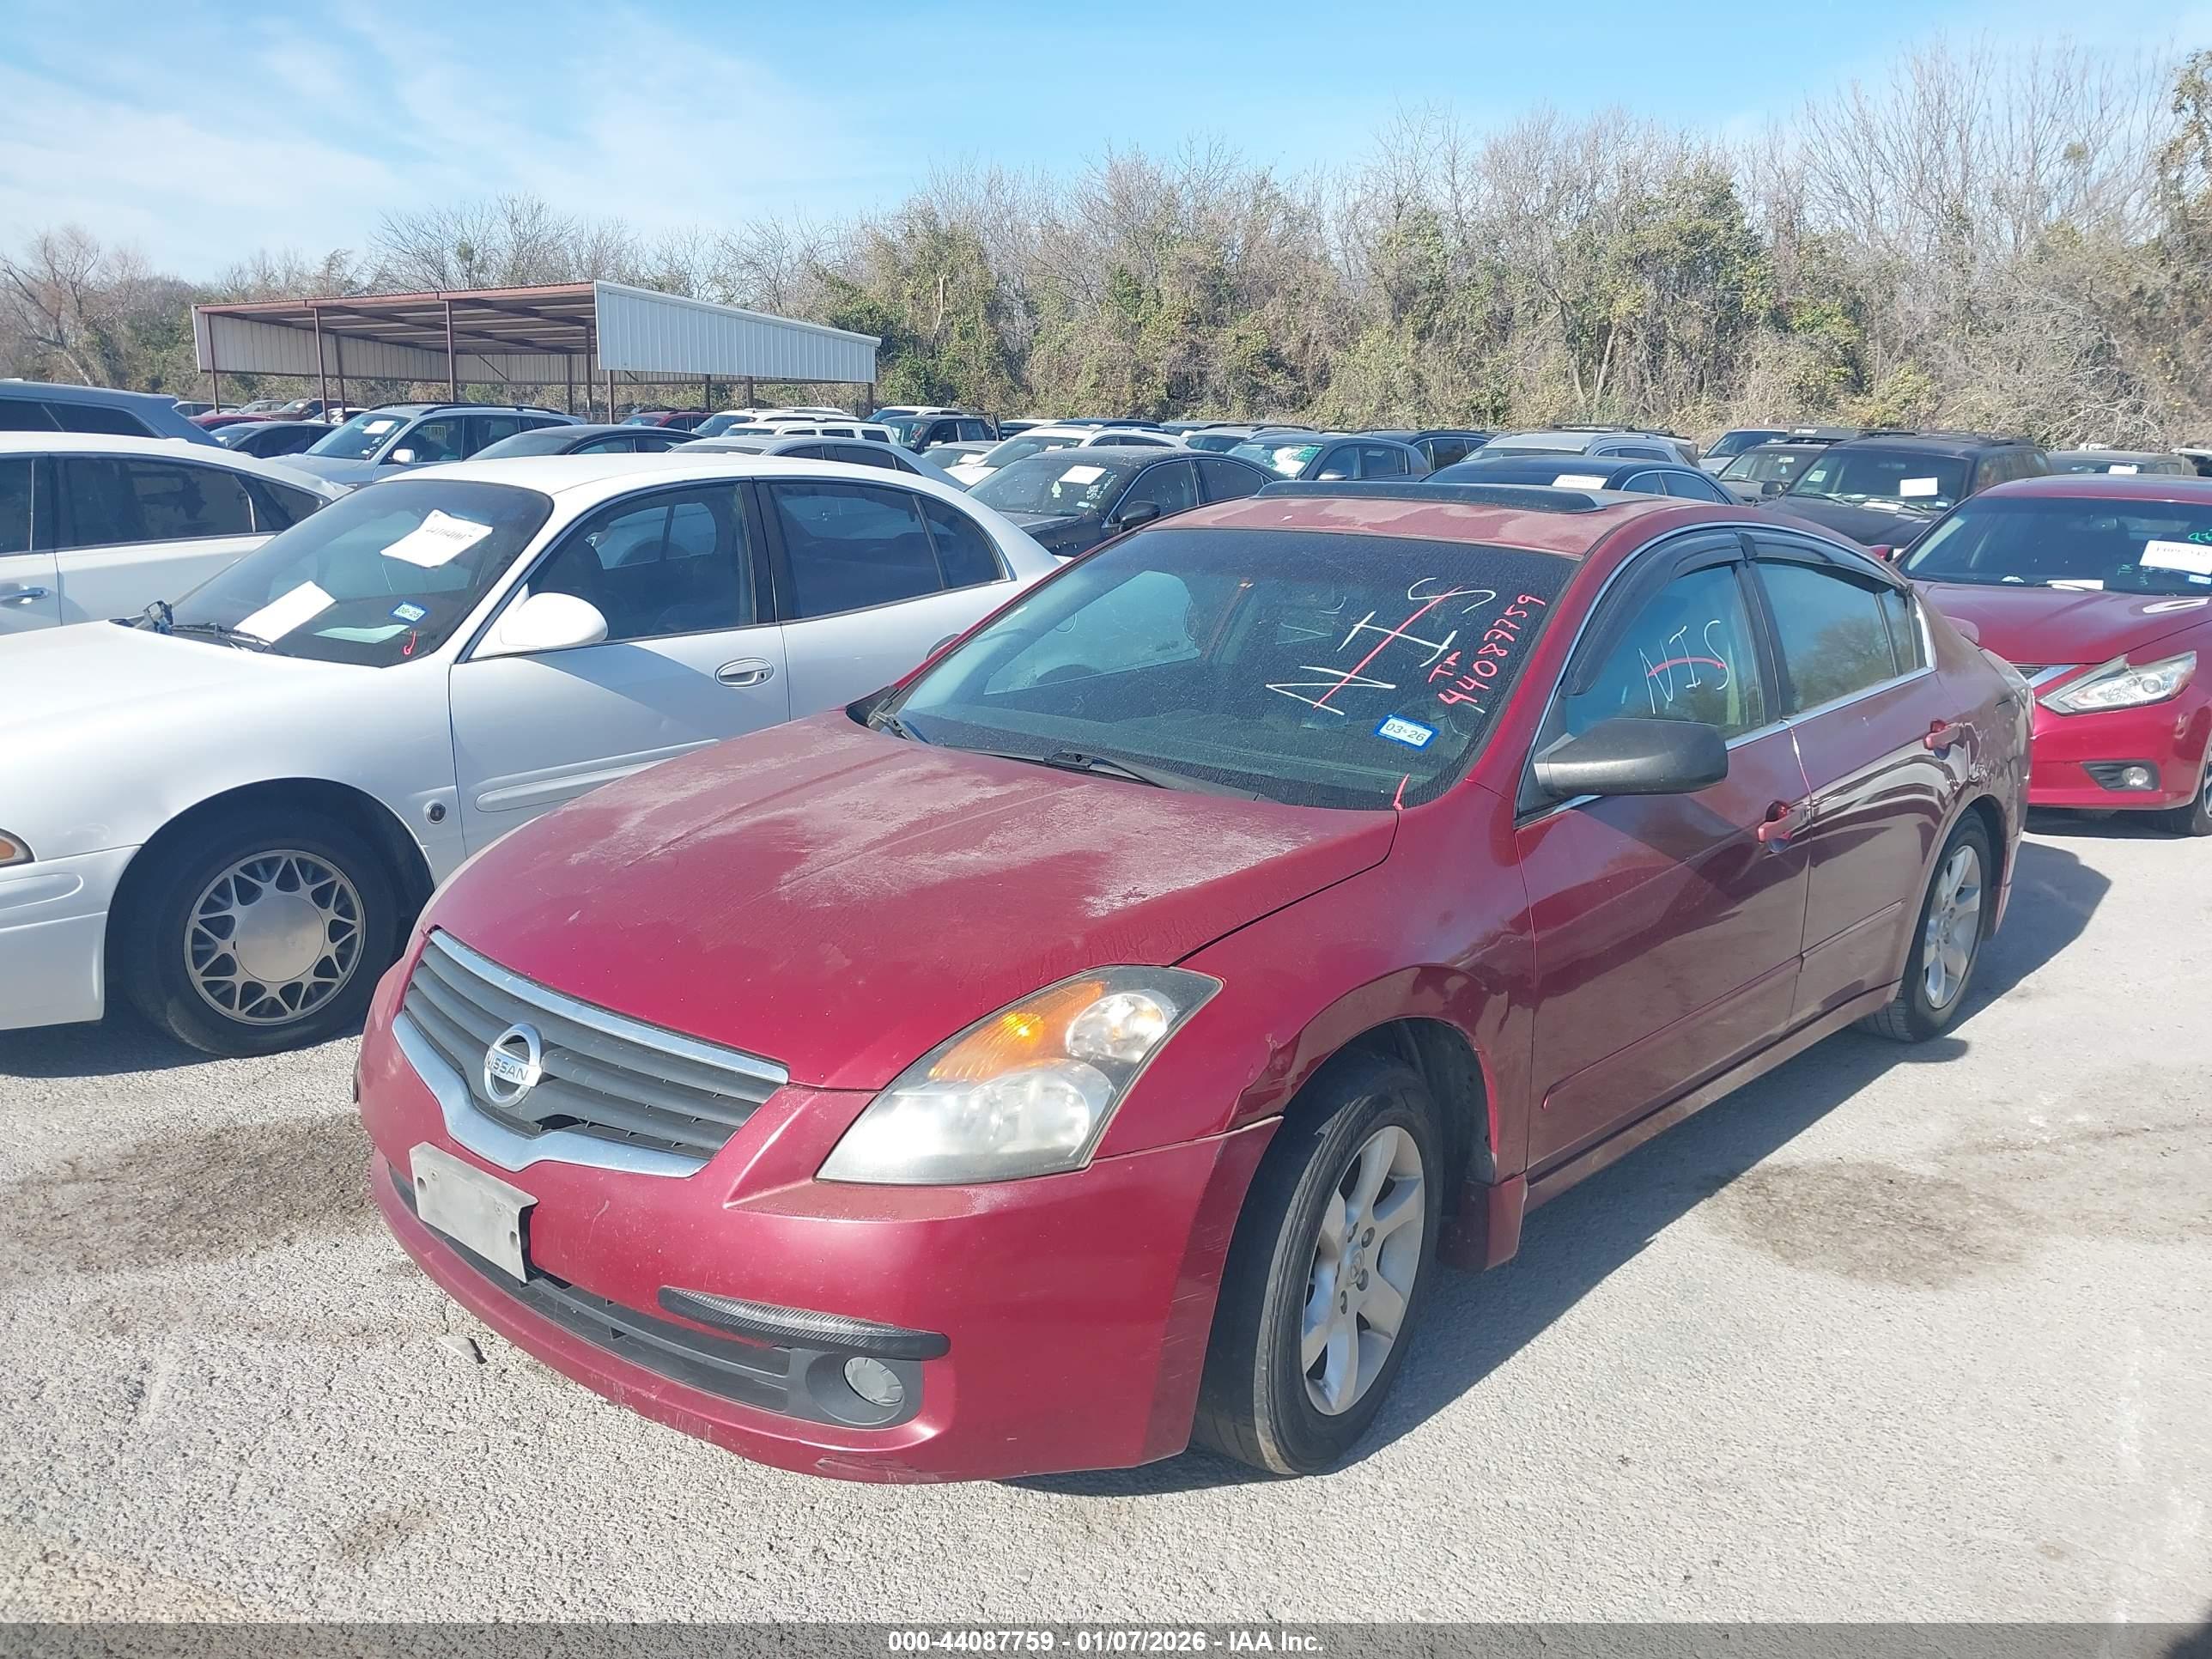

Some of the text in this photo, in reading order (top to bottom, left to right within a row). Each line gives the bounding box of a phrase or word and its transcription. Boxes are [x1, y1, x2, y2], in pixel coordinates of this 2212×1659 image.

[1437, 594, 1546, 704] 44087759
[1638, 619, 1729, 714] NIS
[486, 1052, 529, 1080] NISSAN
